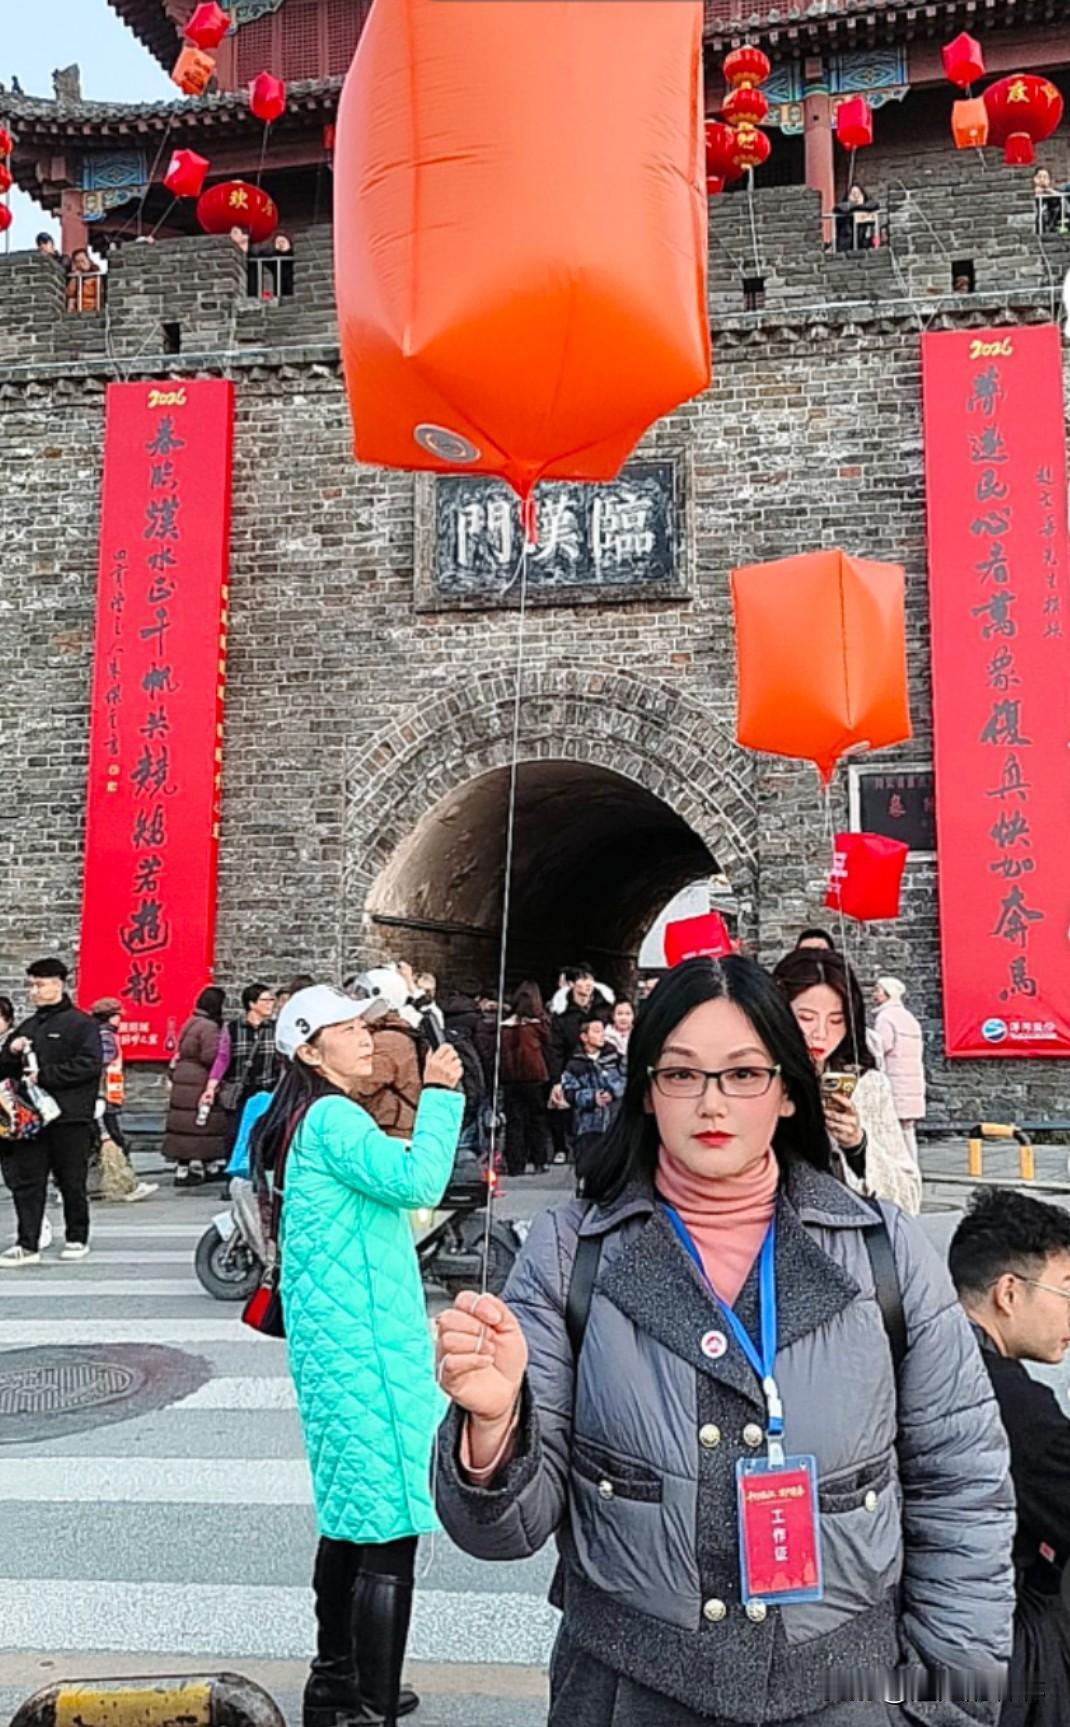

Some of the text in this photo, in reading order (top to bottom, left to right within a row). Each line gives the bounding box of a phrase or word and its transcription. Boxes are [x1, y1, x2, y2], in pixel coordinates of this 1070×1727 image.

[969, 337, 1013, 359] 2026
[148, 388, 187, 409] 2026
[295, 1017, 311, 1035] 3
